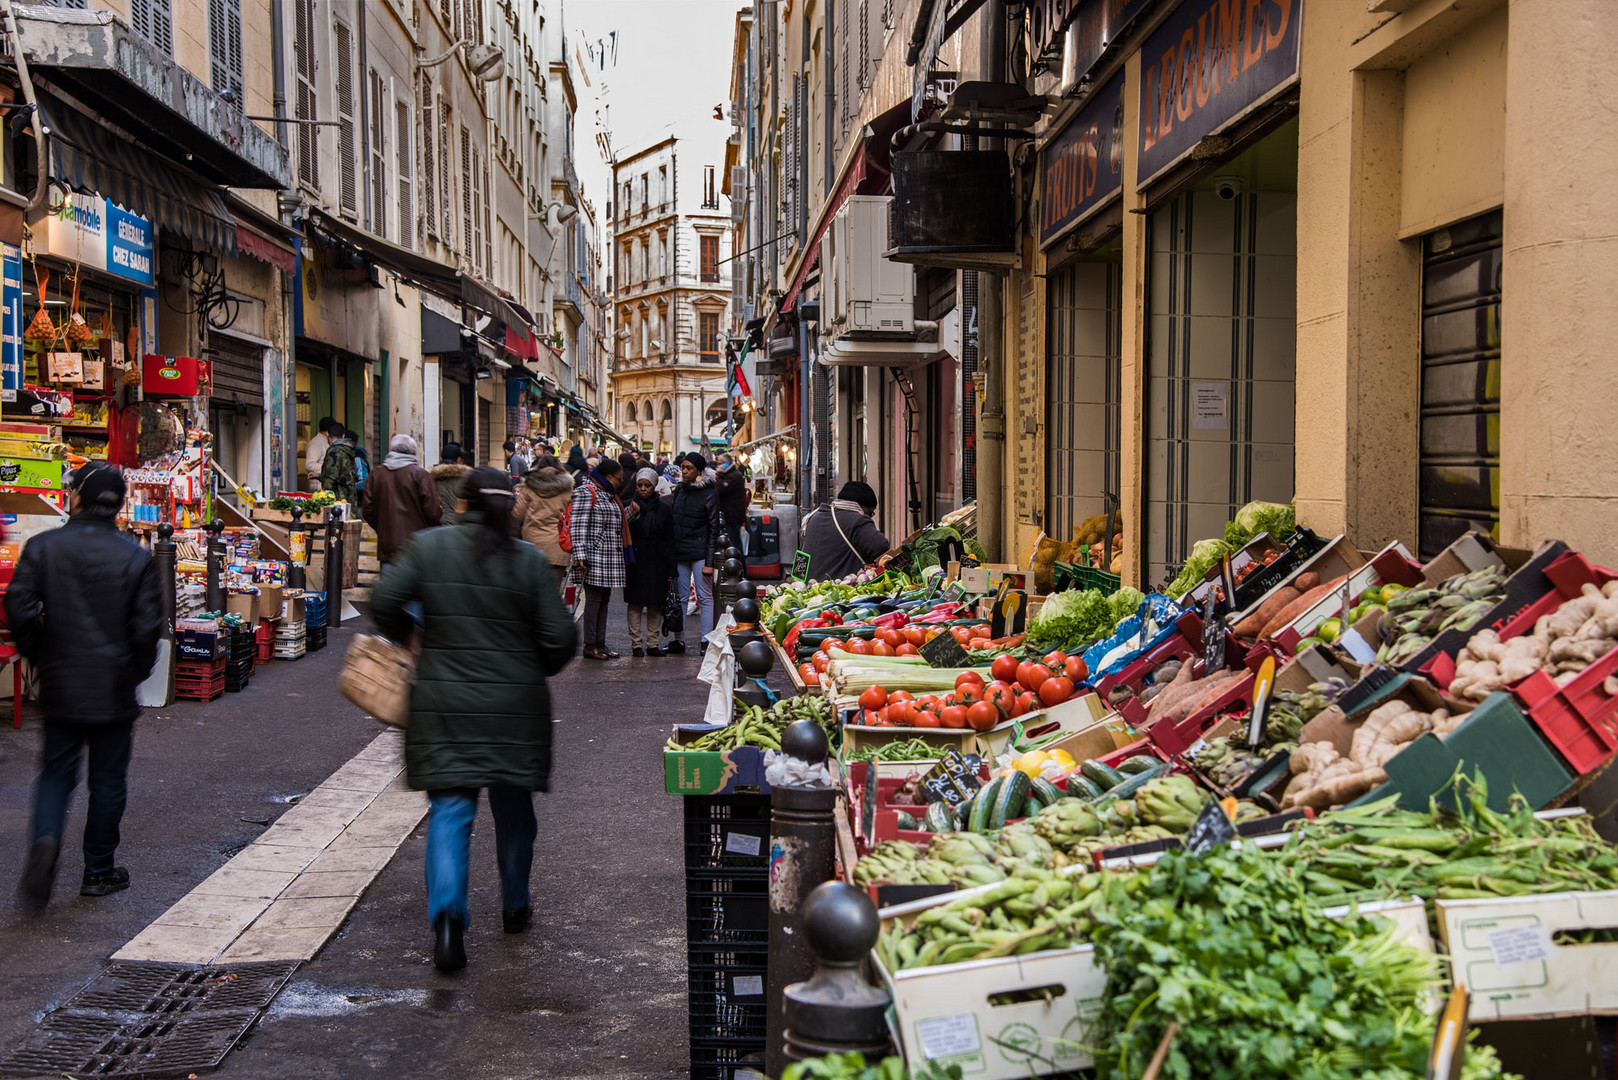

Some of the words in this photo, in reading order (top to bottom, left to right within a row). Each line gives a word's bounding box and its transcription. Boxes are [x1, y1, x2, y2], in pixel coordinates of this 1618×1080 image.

[1143, 0, 1292, 152] LEGUMES
[1043, 122, 1099, 232] FRUITS
[112, 245, 129, 267] CHEZ
[129, 251, 150, 274] SARAH
[118, 217, 145, 247] GÉNÉRALE
